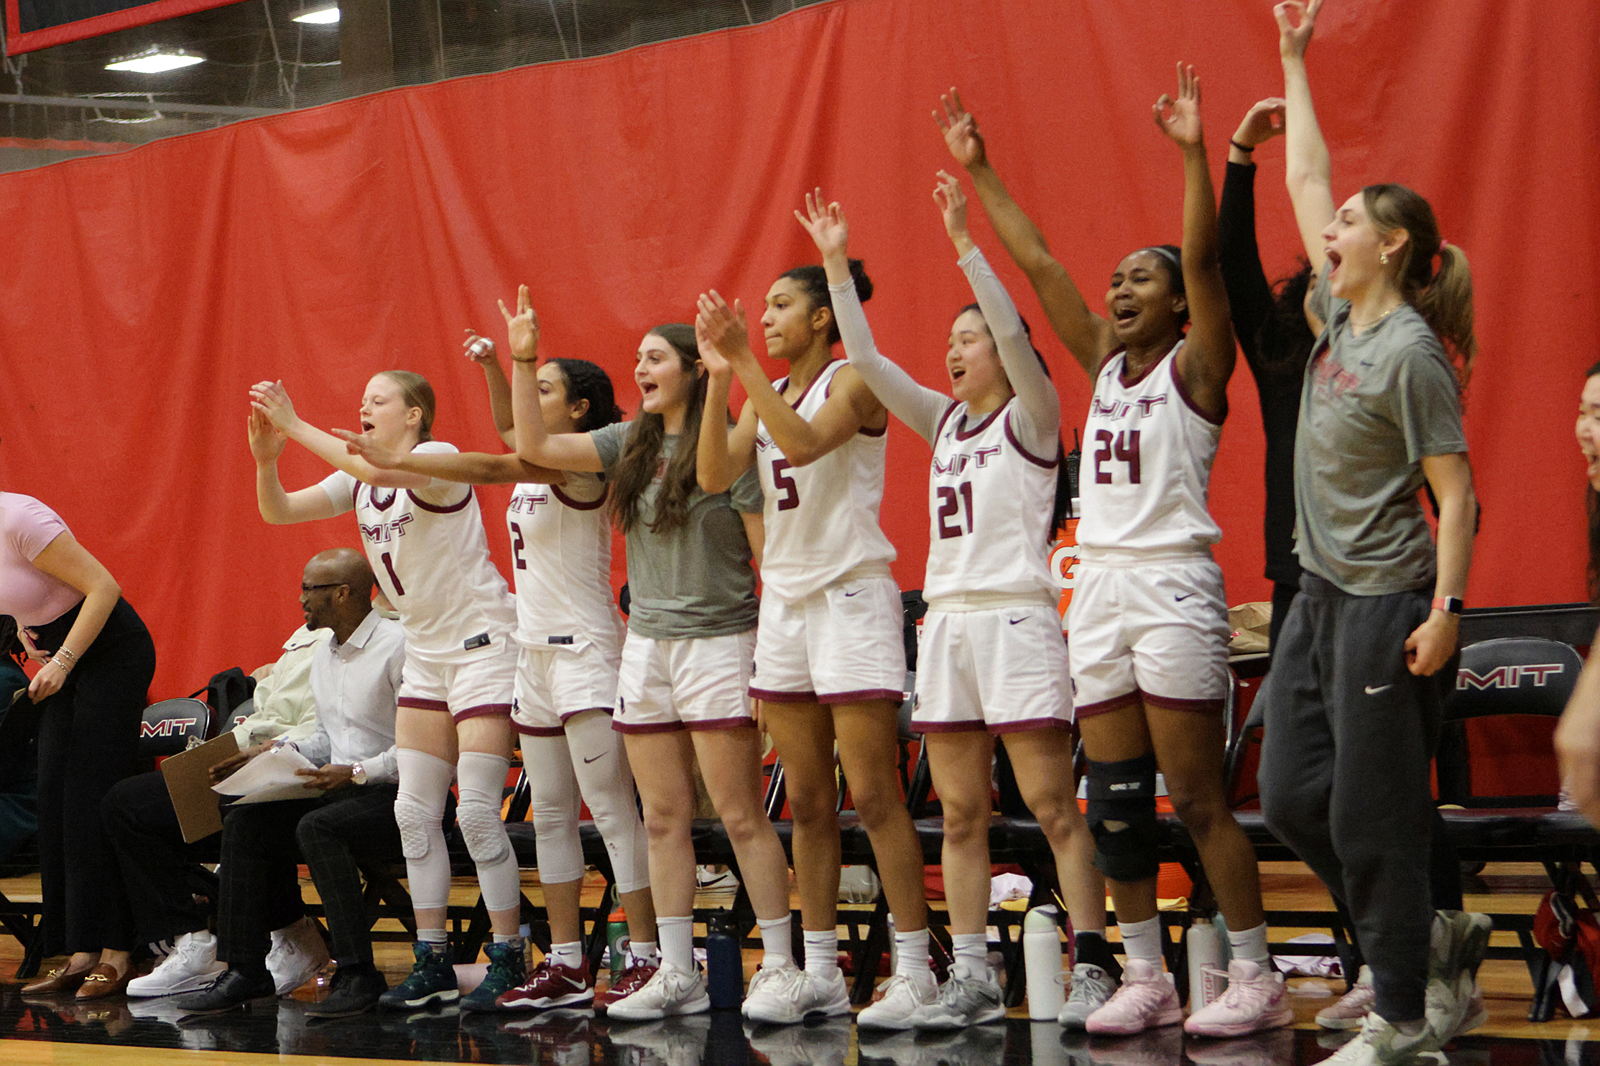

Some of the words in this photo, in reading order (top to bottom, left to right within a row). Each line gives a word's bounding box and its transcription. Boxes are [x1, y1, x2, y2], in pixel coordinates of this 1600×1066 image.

[1092, 393, 1168, 421] MIT
[932, 444, 1001, 478] MIT
[1094, 429, 1141, 484] 24
[772, 458, 800, 511] 5
[360, 512, 414, 544] MIT
[937, 481, 973, 539] 21
[510, 521, 527, 570] 2
[381, 552, 405, 596] 1
[1050, 546, 1080, 589] G
[1456, 663, 1564, 690] MIT
[139, 718, 197, 738] MIT
